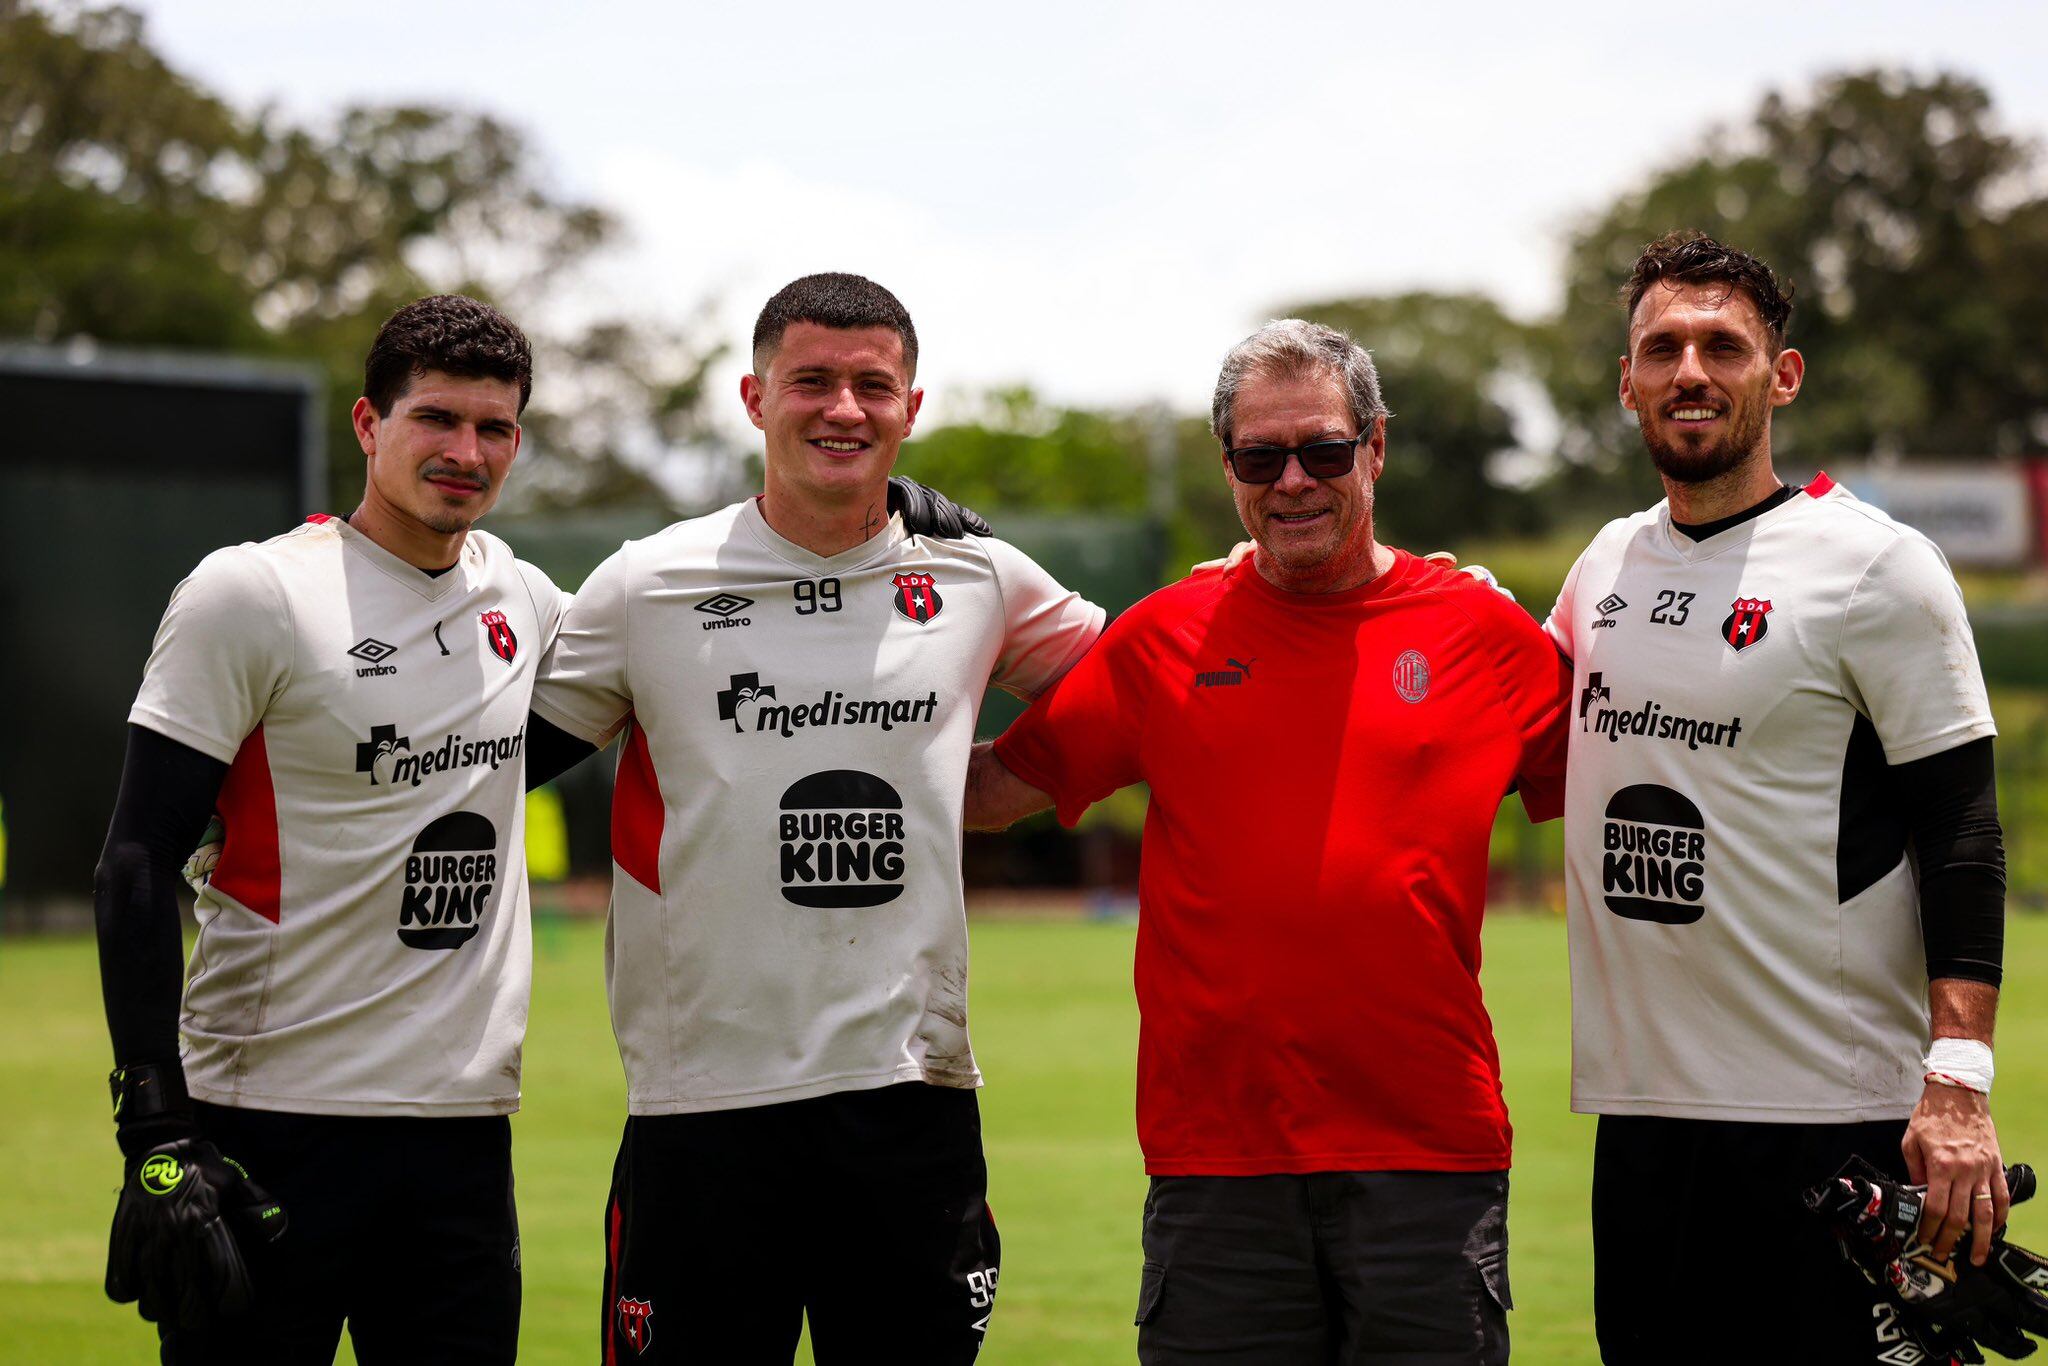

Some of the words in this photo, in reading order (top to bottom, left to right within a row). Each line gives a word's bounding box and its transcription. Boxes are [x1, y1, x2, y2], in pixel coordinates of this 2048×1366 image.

[793, 577, 843, 615] 99
[901, 577, 929, 587] LDA
[485, 614, 505, 625] LDA
[702, 616, 751, 631] umbro
[1650, 589, 1696, 626] 23
[1737, 601, 1764, 612] LDA
[433, 620, 450, 656] 1
[356, 663, 397, 678] umbro
[757, 691, 938, 738] medismart
[1595, 701, 1742, 751] medismart
[391, 725, 524, 787] medismart
[779, 812, 906, 841] BURGER
[1604, 822, 1705, 861] BURGER
[405, 854, 496, 884] BURGER
[780, 841, 905, 883] KING
[1603, 852, 1704, 901] KING
[622, 1304, 643, 1315] LDA
[1872, 1302, 1906, 1343] 2
